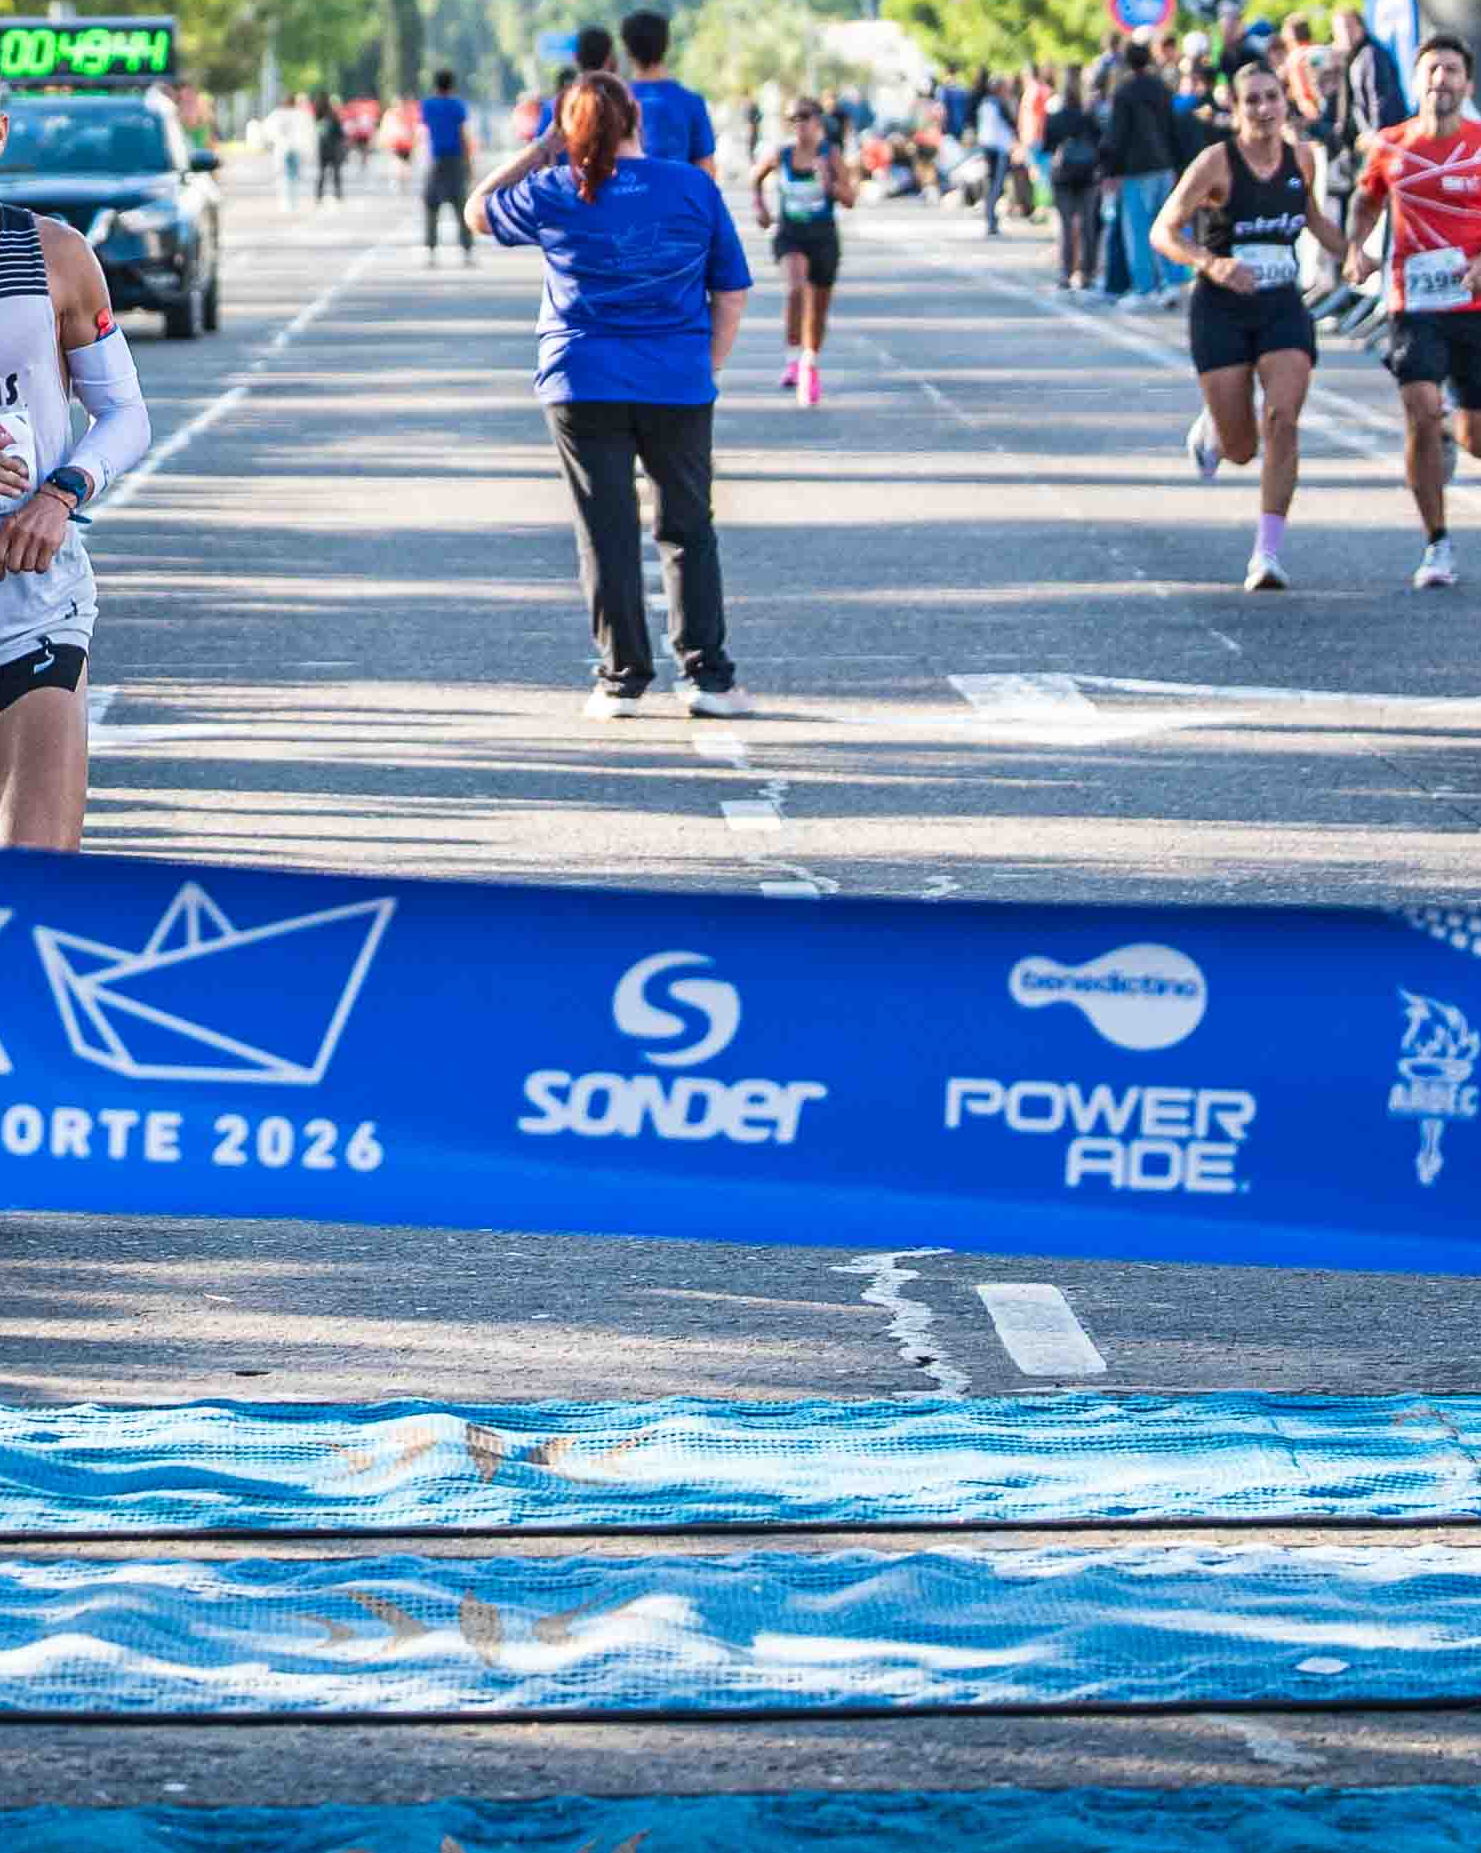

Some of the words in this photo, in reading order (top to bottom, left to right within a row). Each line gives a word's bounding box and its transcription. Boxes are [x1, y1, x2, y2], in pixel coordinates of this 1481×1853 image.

[945, 1077, 1255, 1140] POWER
[212, 1113, 384, 1171] 2026
[1064, 1136, 1238, 1193] ADE
